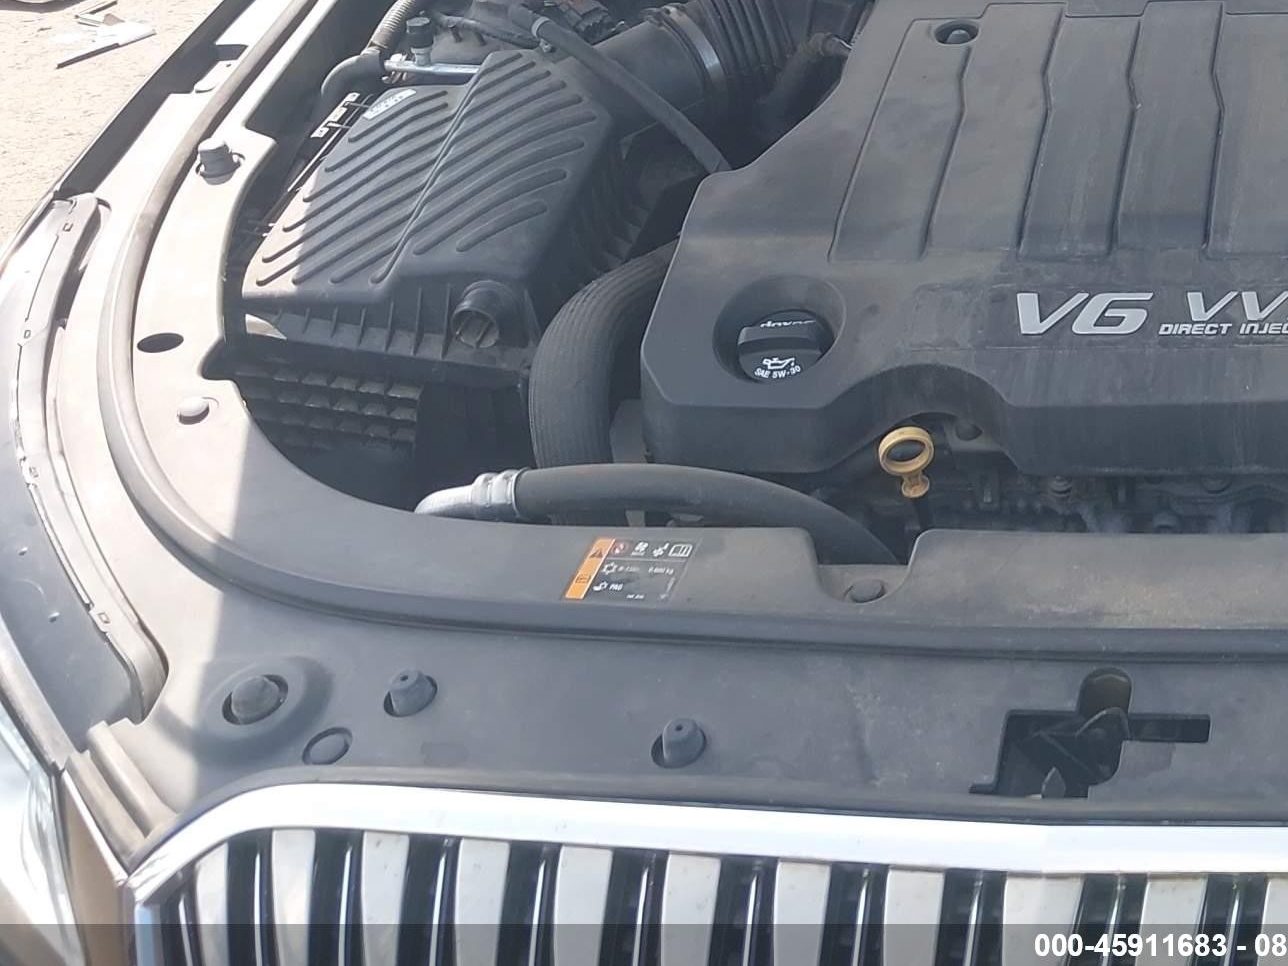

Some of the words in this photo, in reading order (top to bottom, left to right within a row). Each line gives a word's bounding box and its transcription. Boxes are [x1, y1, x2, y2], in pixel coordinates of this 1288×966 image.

[1016, 291, 1154, 335] V6
[1158, 323, 1233, 335] DIRECT
[754, 367, 771, 379] SAE
[772, 365, 801, 379] 5W-30
